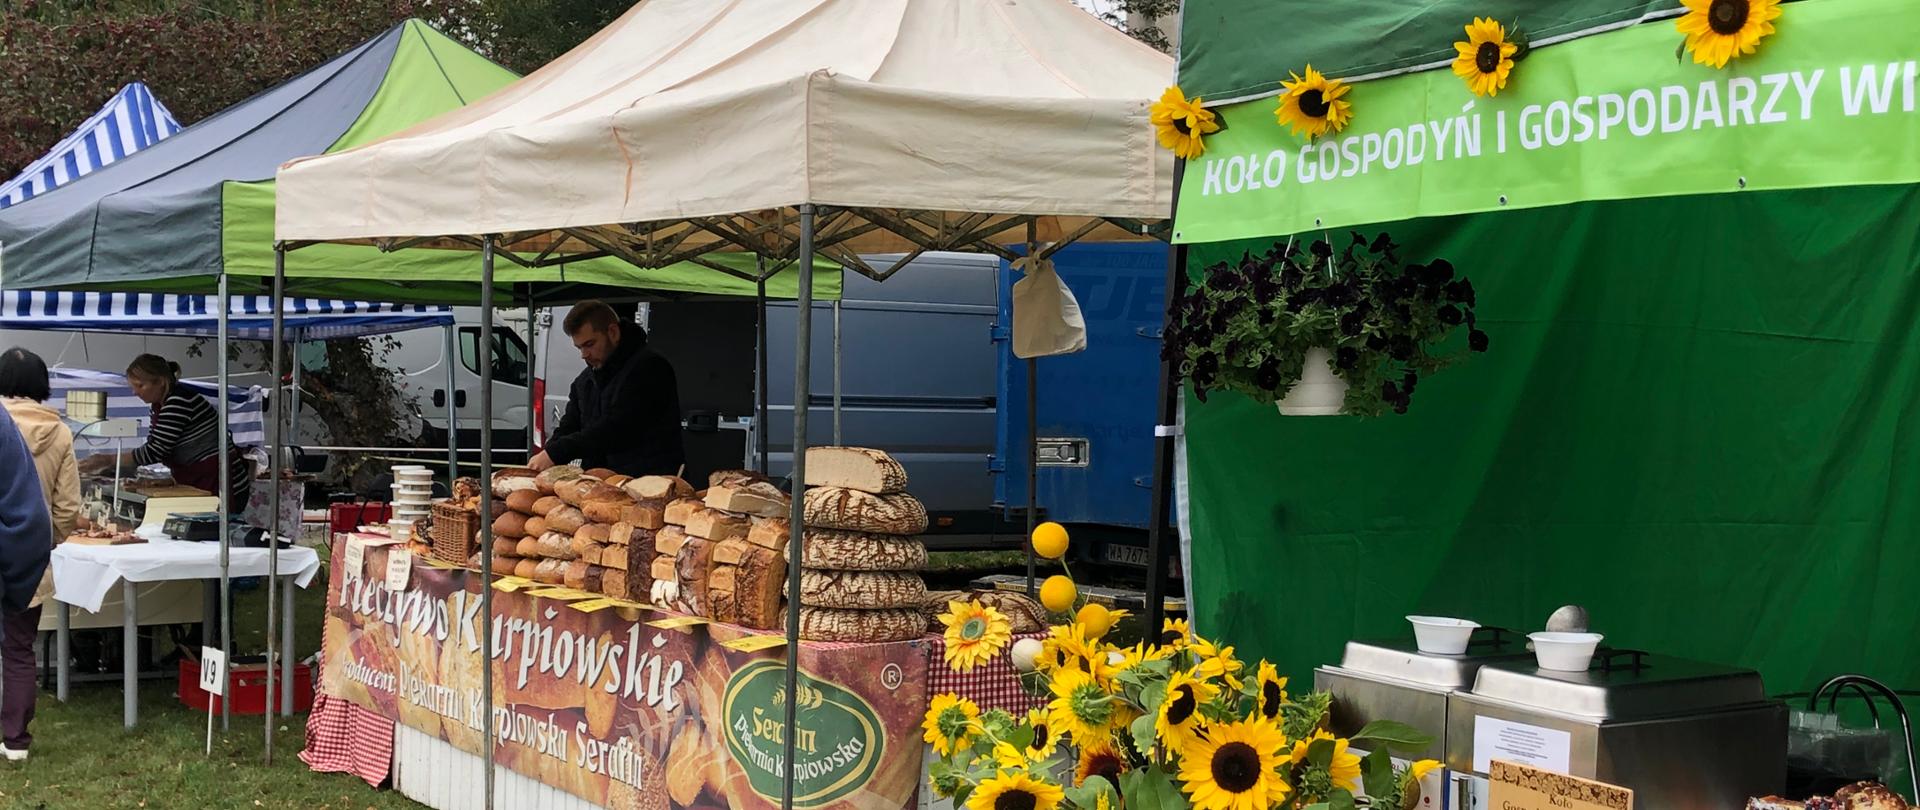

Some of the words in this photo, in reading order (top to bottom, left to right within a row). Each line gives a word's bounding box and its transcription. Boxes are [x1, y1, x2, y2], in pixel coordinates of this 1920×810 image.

[1202, 149, 1287, 196] KOŁO
[1296, 99, 1481, 184] GOSPODYŃ
[1496, 110, 1506, 153] I
[1518, 69, 1825, 151] GOSPODARZY
[469, 687, 568, 763] Krpiowska
[575, 720, 644, 791] Serafin
[751, 706, 818, 756] Serain
[775, 736, 865, 785] Krpiowska
